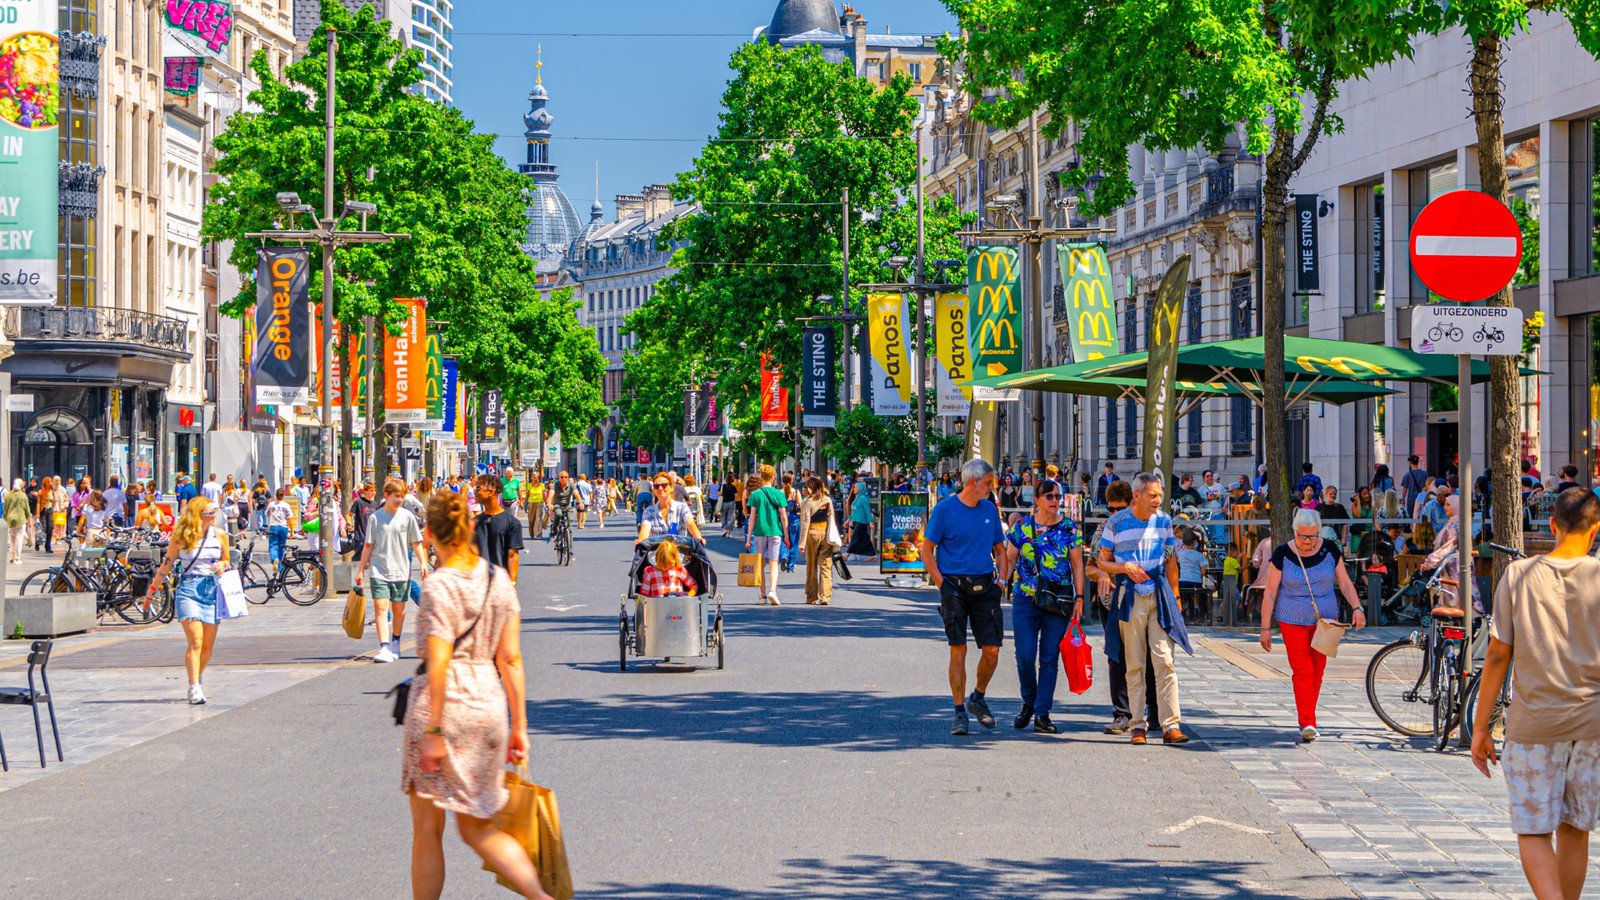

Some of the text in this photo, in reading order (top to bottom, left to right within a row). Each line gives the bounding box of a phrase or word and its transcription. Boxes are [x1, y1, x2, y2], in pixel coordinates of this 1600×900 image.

[4, 136, 23, 156] IN
[1301, 210, 1313, 273] THE STING
[268, 258, 297, 361] Orange
[1433, 307, 1508, 317] UITGEZONDERD
[884, 314, 900, 389] Panos
[949, 308, 965, 380] Panos
[1487, 344, 1493, 352] P
[812, 332, 825, 409] THE STING
[485, 392, 497, 426] fnac
[891, 514, 922, 523] Wacko
[891, 522, 922, 530] GUACO
